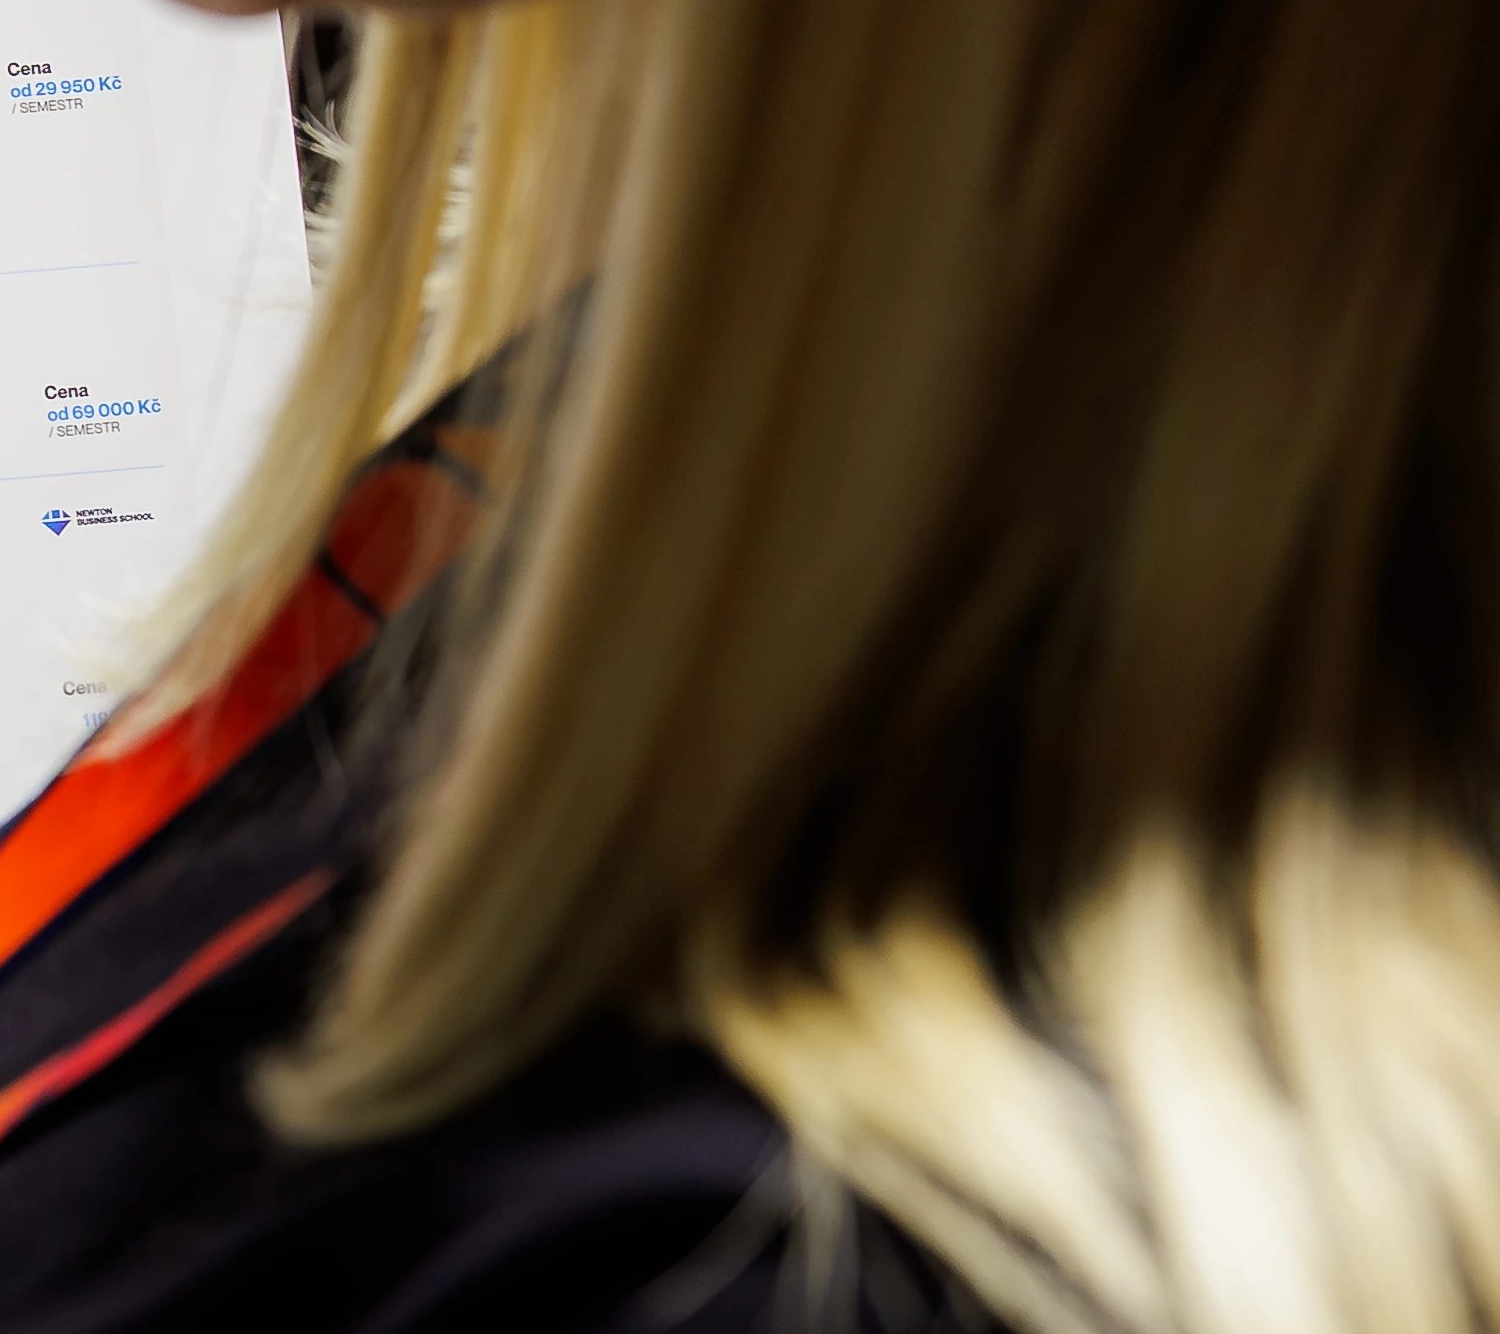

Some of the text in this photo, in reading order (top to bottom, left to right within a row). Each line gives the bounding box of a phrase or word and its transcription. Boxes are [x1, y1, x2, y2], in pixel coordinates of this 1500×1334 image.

[8, 63, 52, 76] Cena
[11, 76, 122, 98] od 29 950 Kč
